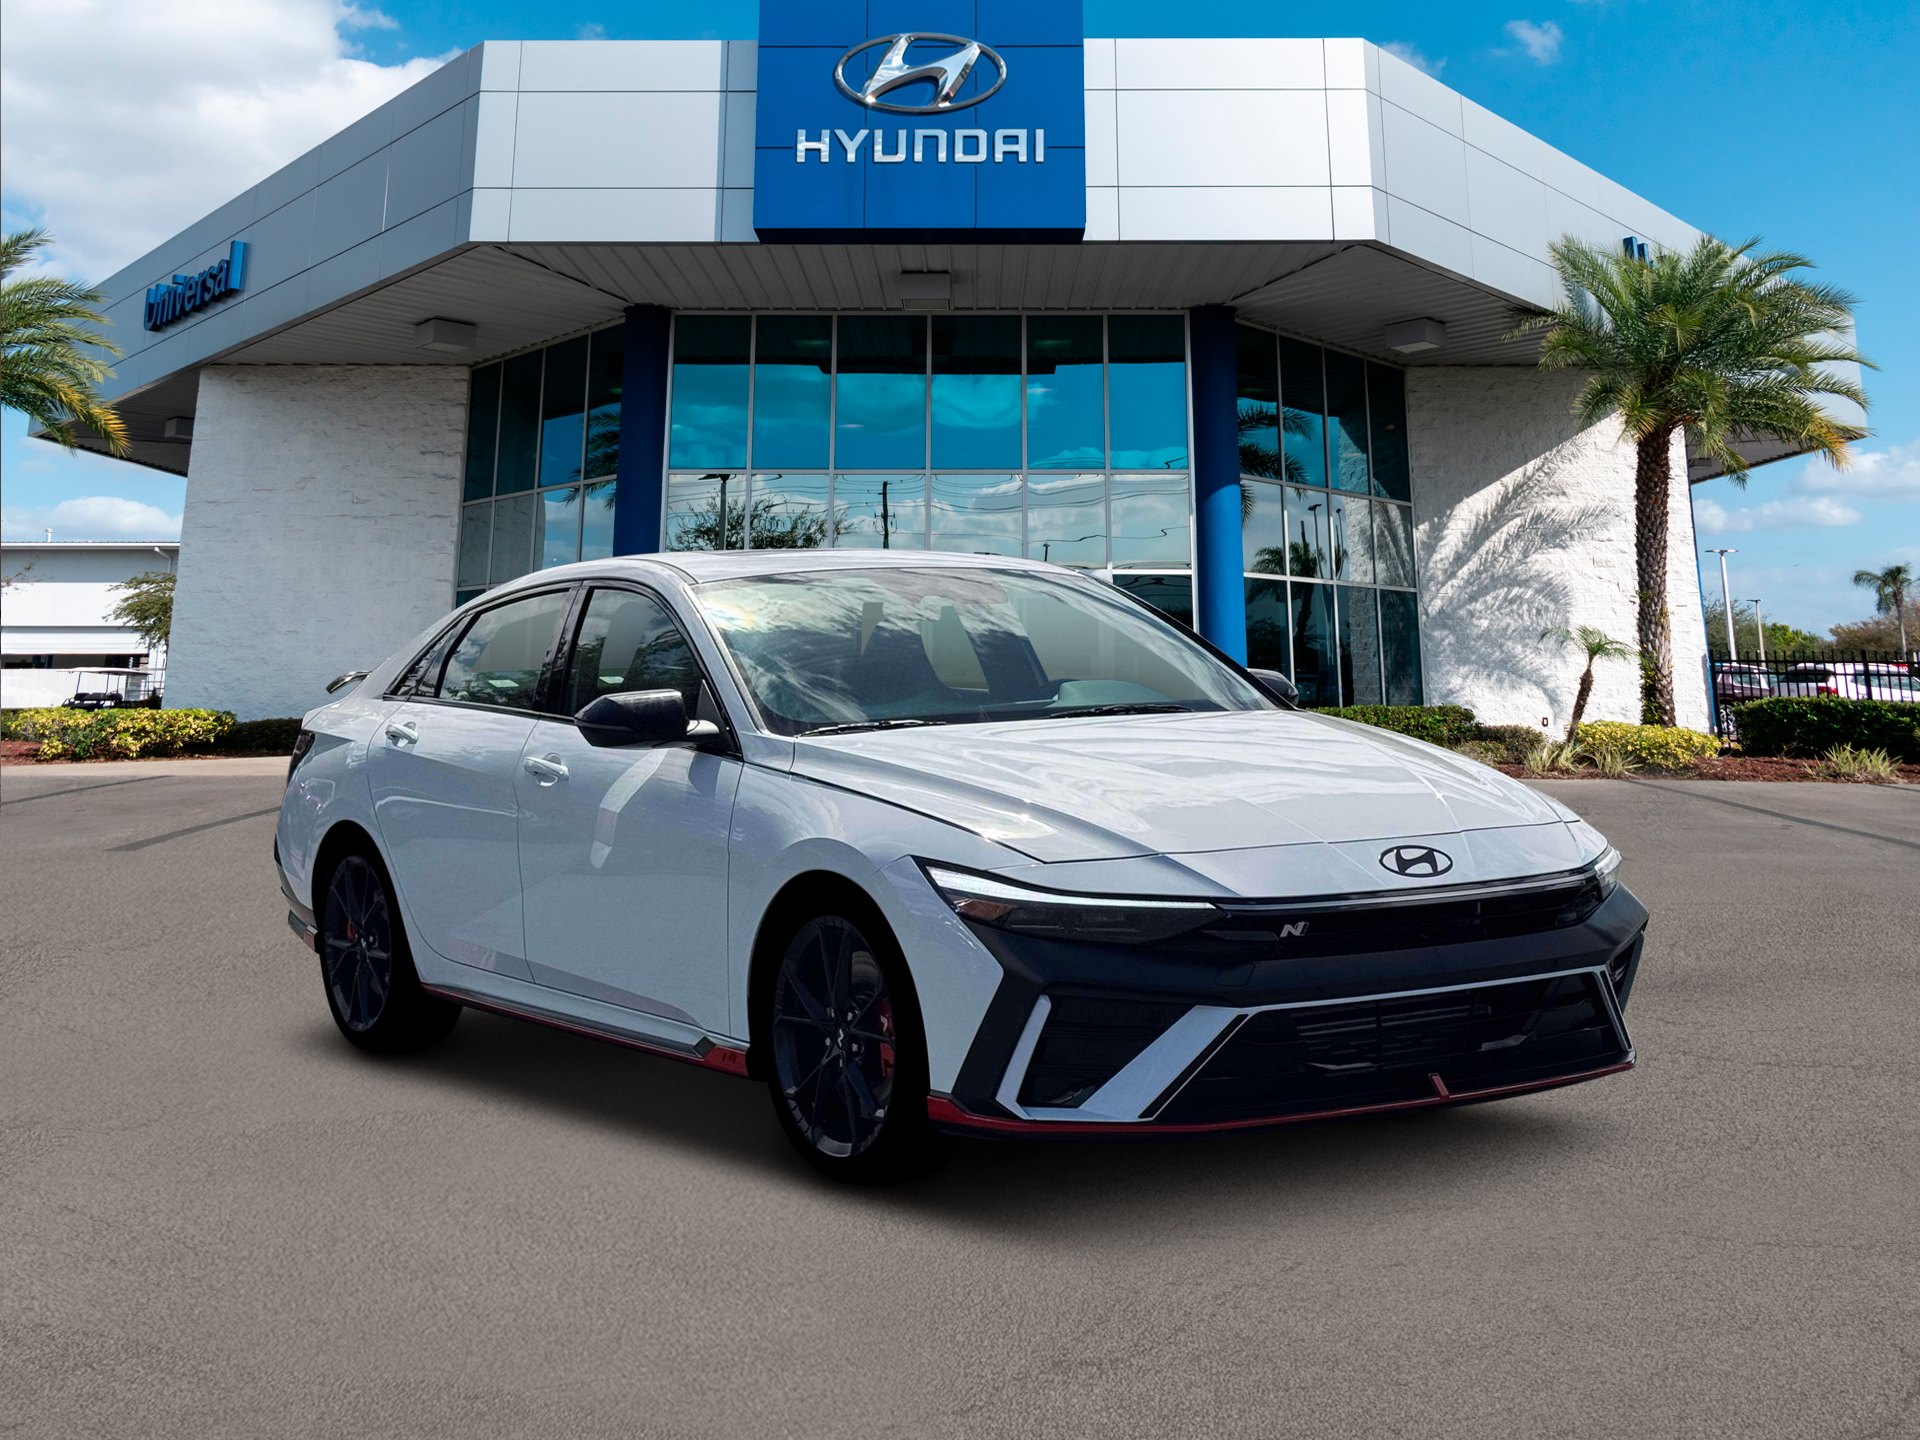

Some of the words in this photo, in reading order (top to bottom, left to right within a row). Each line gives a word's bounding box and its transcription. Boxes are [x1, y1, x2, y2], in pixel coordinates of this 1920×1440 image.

[796, 129, 1044, 163] HYUNDAI
[144, 240, 246, 332] Universal
[1280, 921, 1309, 938] N
